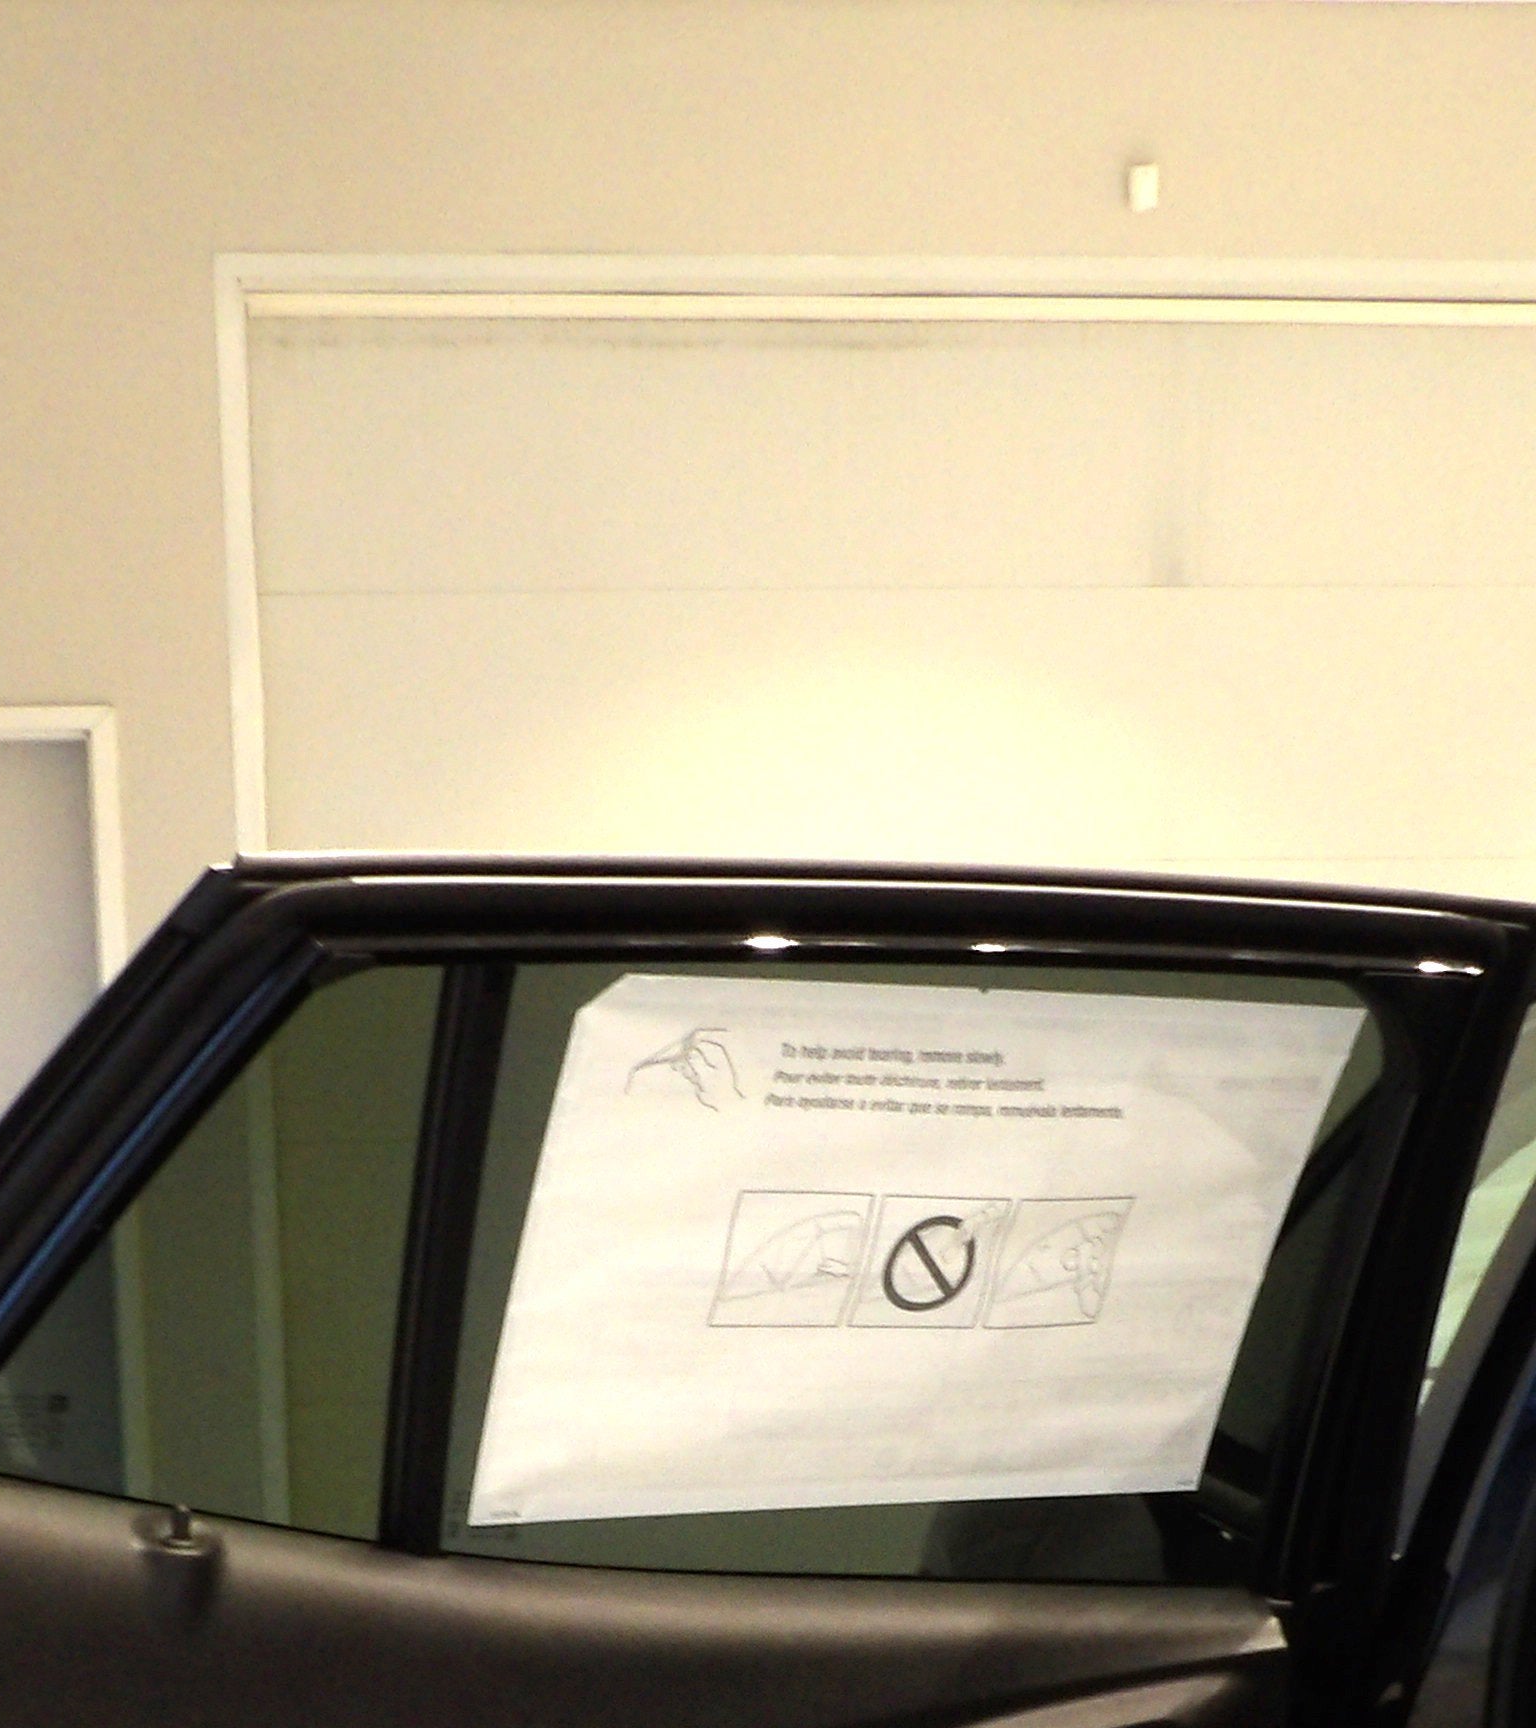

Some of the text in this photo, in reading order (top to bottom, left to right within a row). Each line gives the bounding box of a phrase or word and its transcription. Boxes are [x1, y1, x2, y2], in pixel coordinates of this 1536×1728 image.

[781, 1042, 796, 1058] To
[800, 1045, 827, 1062] help
[832, 1046, 865, 1061] avoid
[918, 1051, 963, 1064] remove
